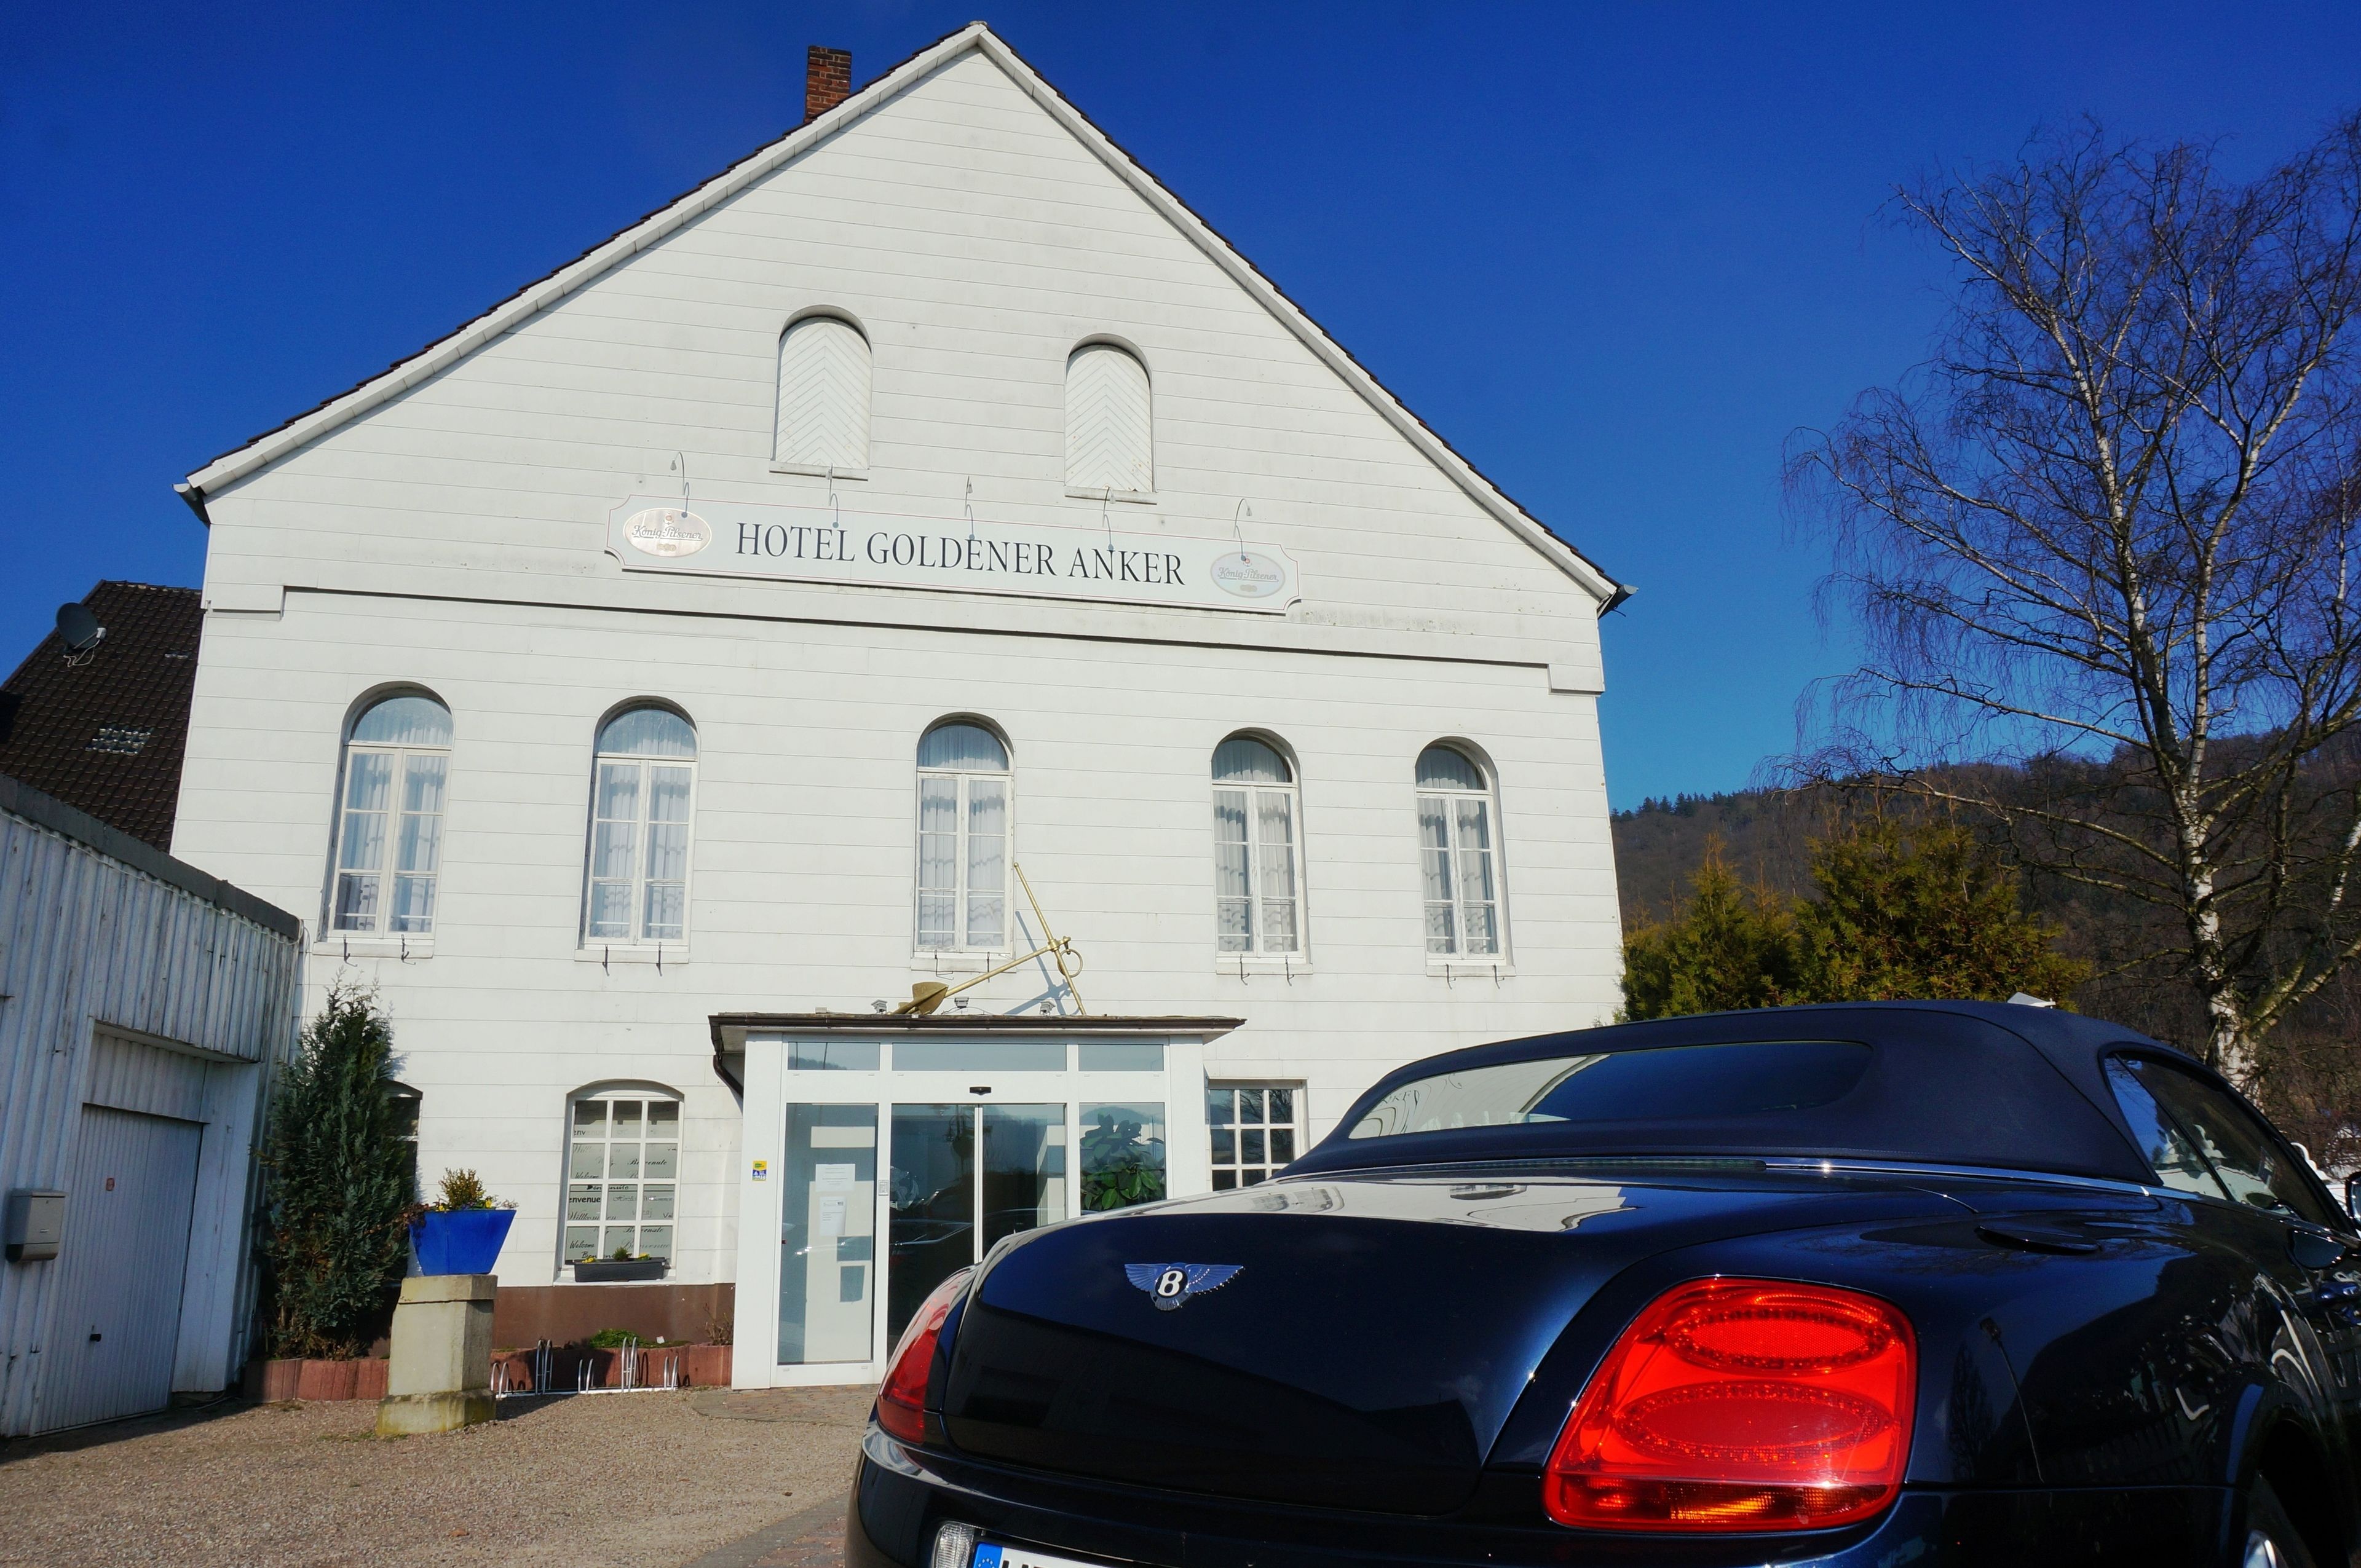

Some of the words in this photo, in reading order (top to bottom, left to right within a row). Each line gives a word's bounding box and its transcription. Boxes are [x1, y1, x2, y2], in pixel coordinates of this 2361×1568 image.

[631, 525, 703, 541] König-Pilsener
[735, 522, 855, 562] HOTEL
[867, 532, 1057, 576] GOLDENER
[1067, 546, 1185, 586] ANKER
[569, 1240, 595, 1249] Welcome
[1158, 1270, 1184, 1296] B
